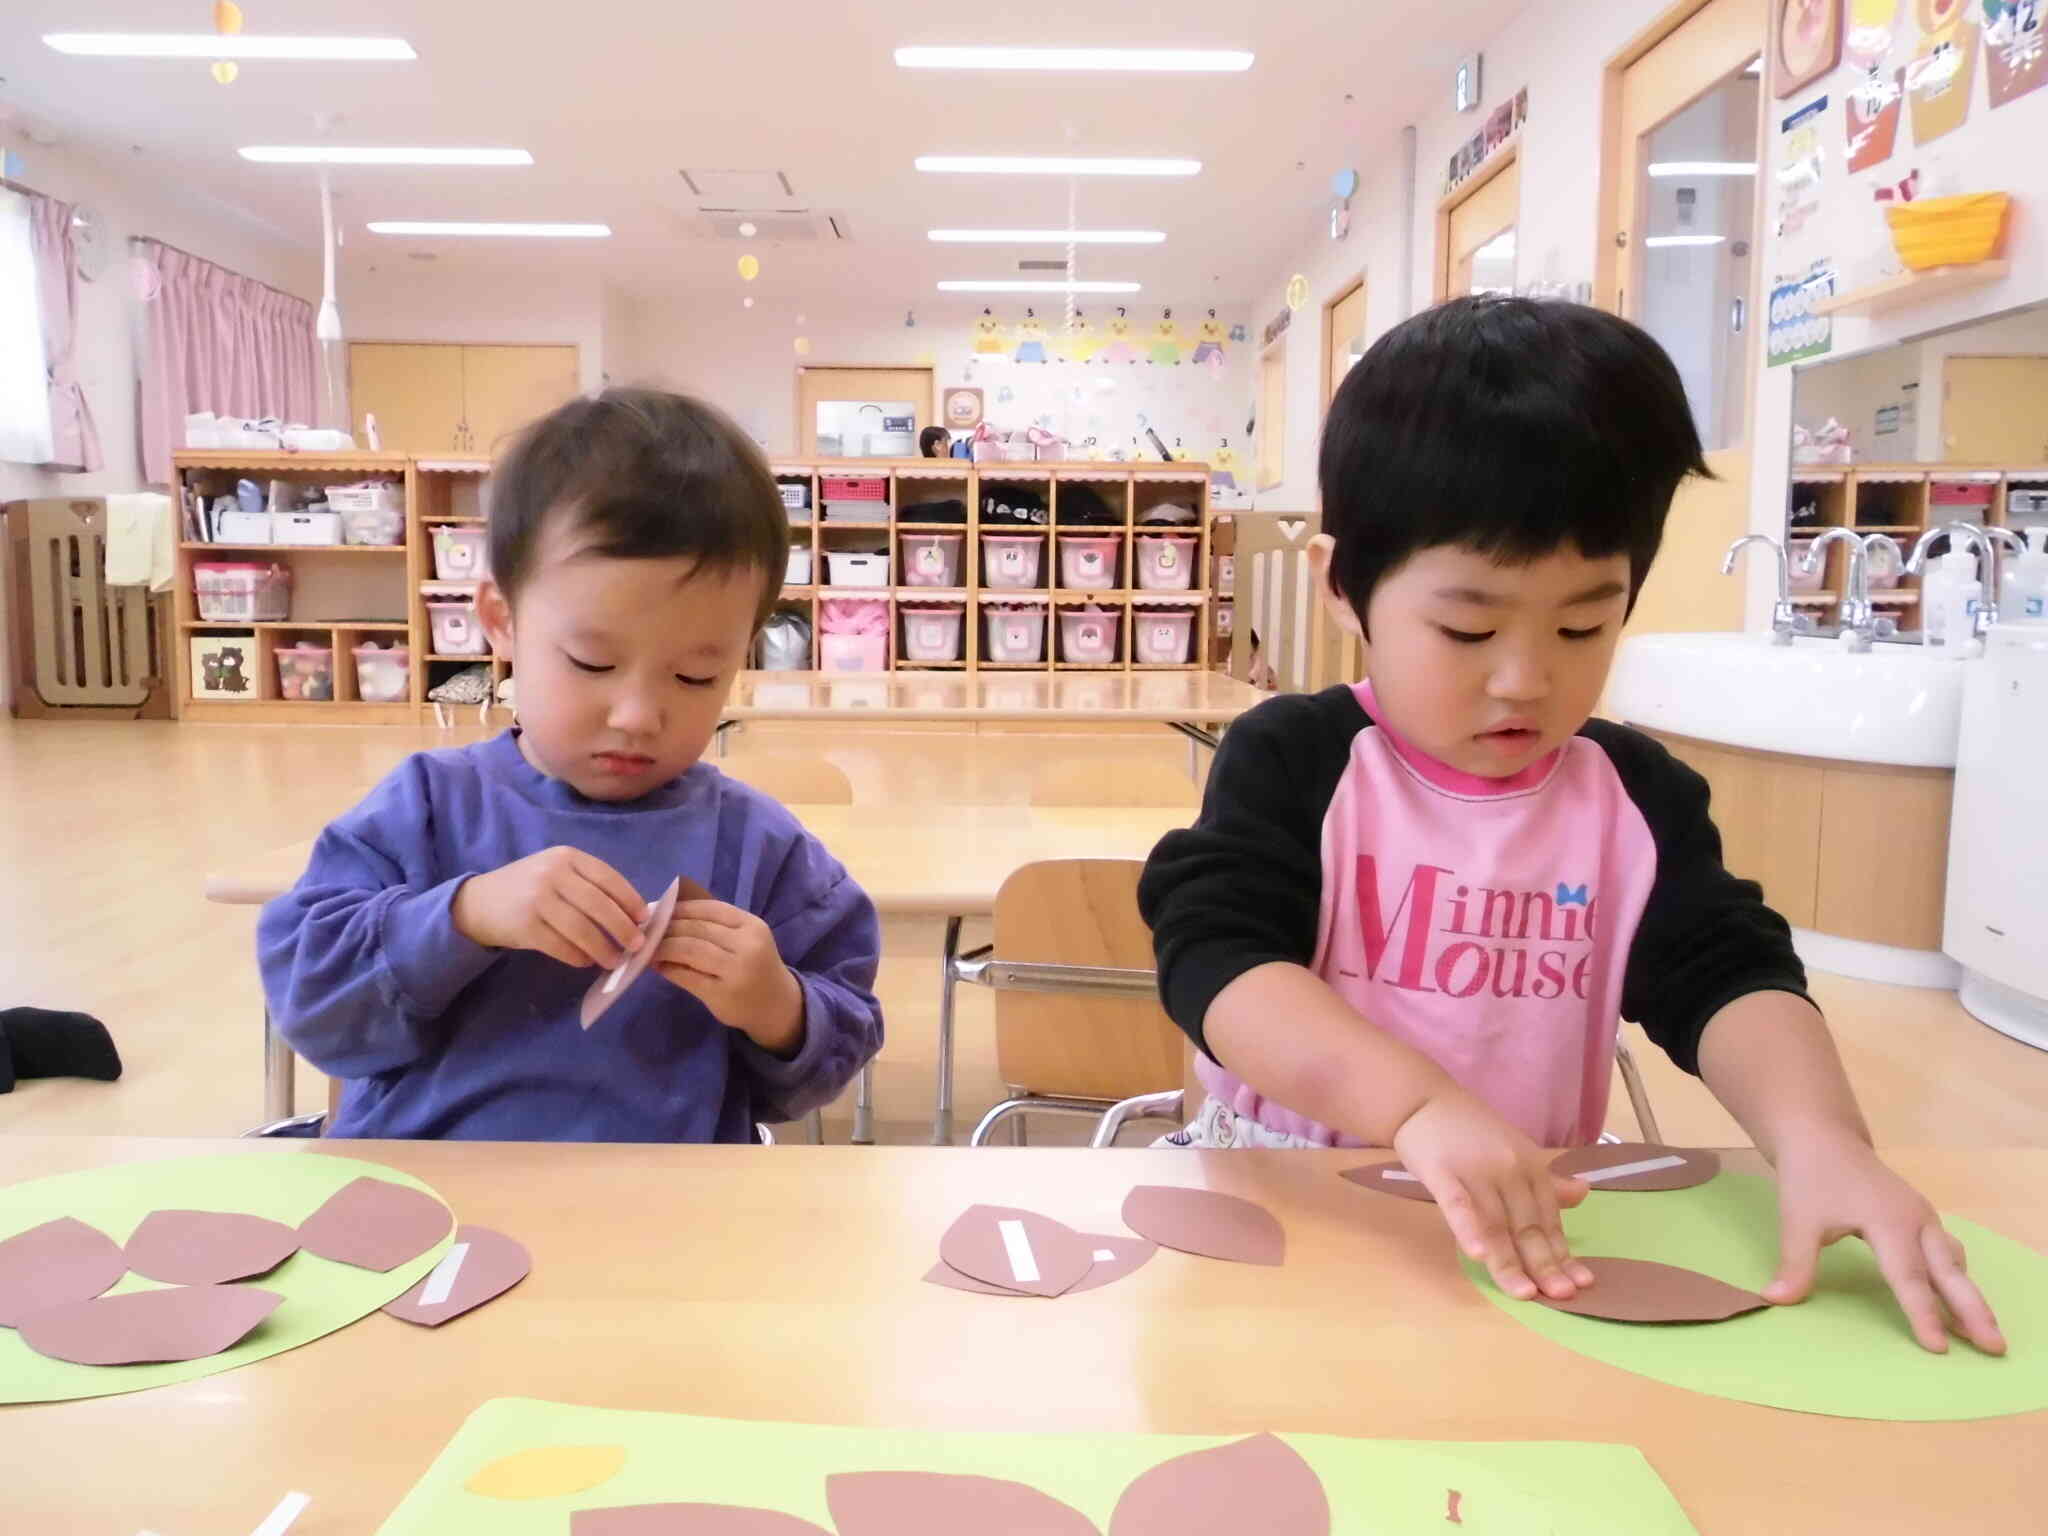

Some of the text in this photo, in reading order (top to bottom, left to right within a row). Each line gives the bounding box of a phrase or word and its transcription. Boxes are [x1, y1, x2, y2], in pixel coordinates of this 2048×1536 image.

[1117, 306, 1126, 318] 7
[1163, 308, 1172, 319] 8
[1207, 308, 1216, 319] 9
